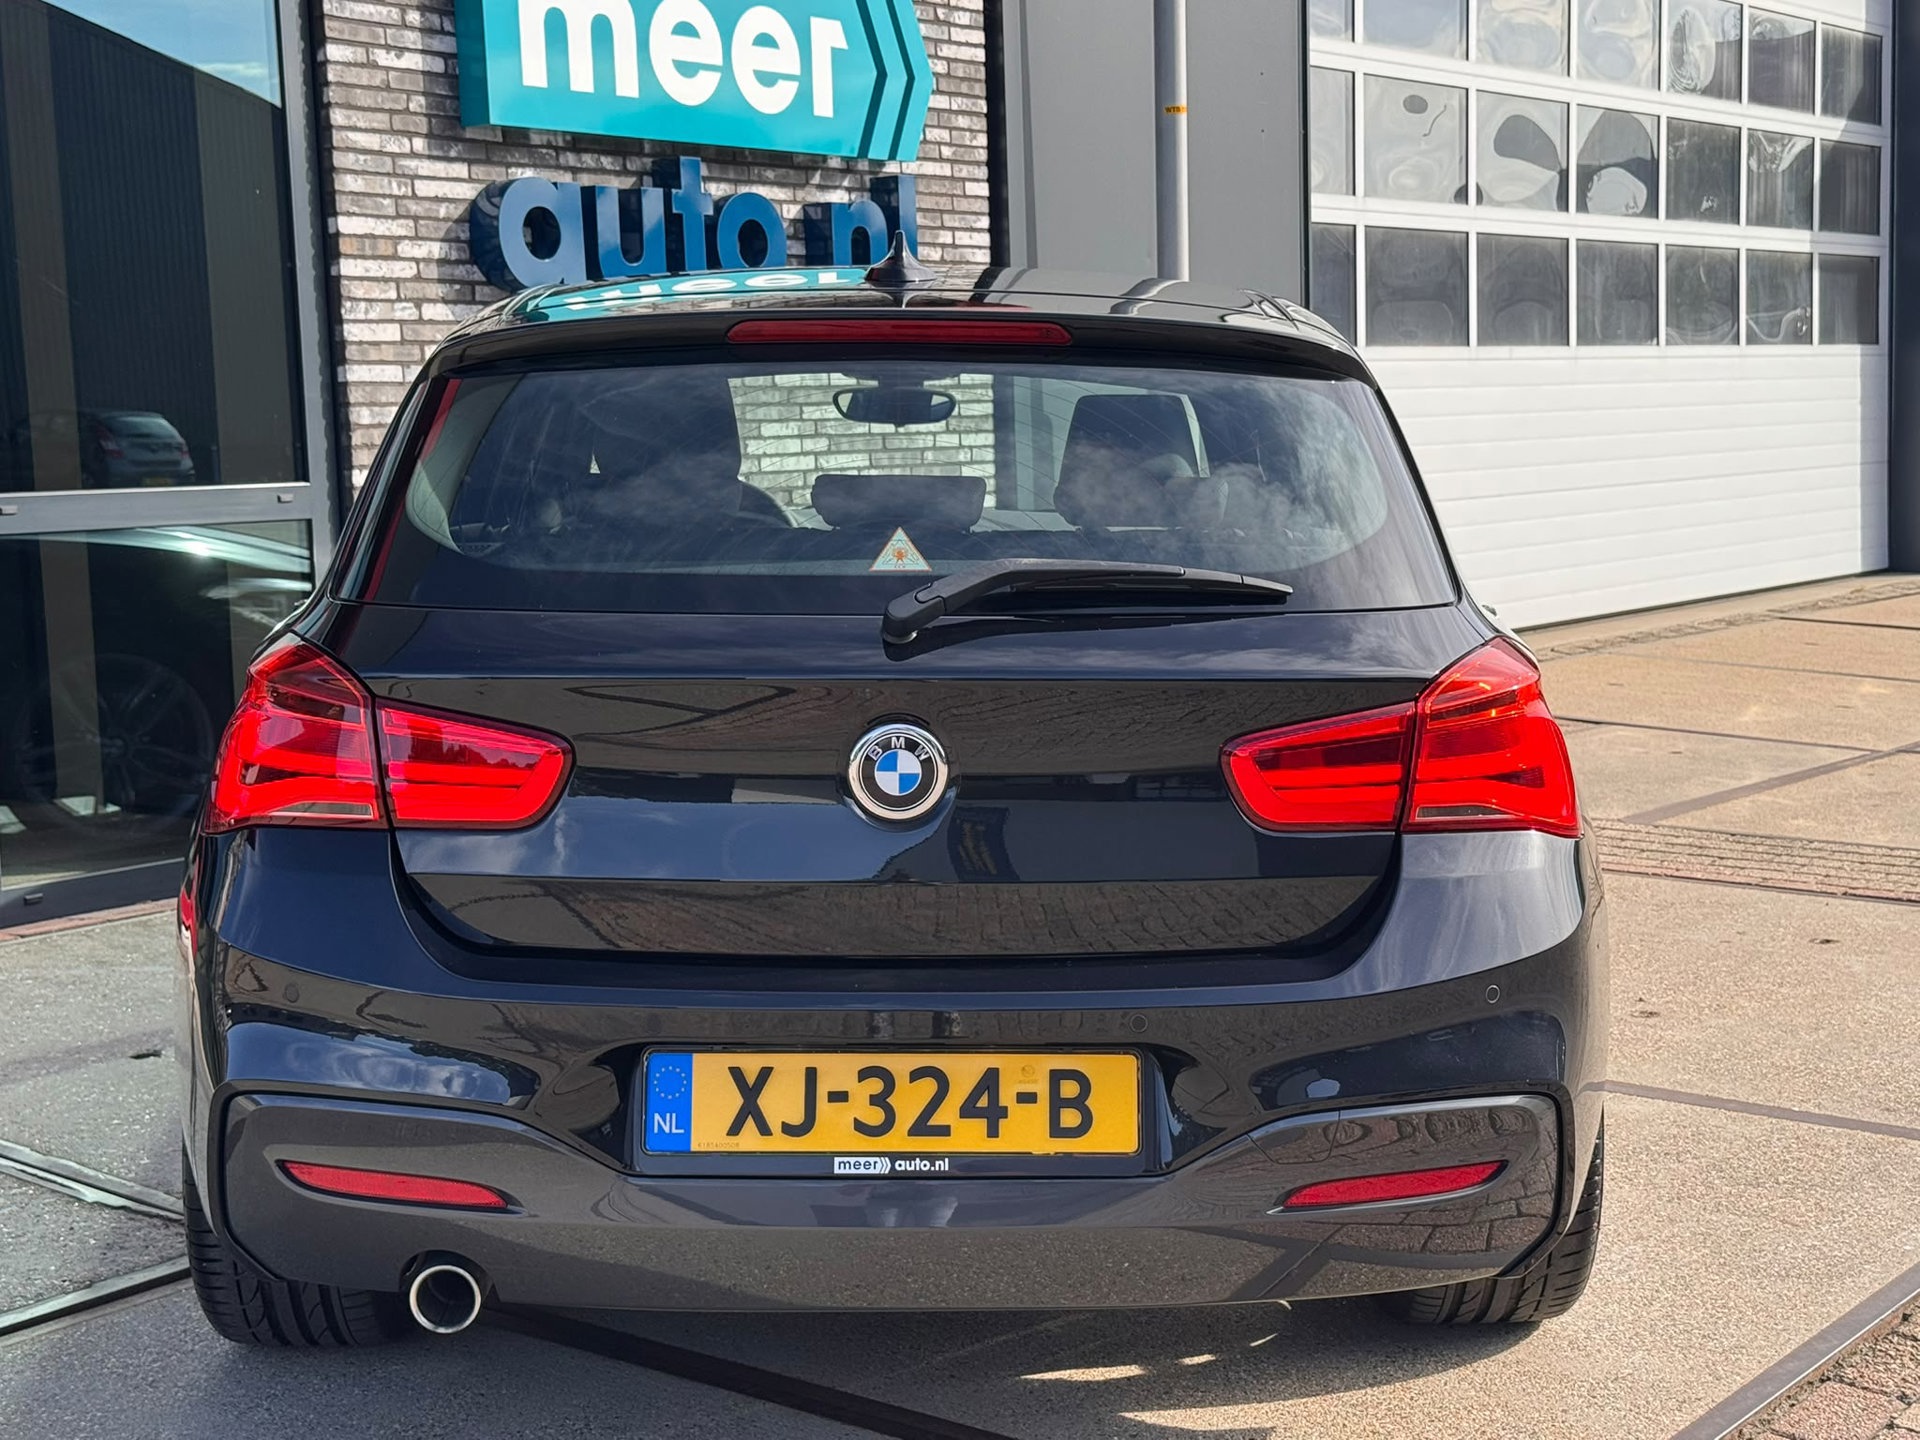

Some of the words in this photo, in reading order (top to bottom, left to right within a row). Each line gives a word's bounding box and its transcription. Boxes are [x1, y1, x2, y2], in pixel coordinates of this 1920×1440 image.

[518, 0, 848, 118] meer
[867, 736, 931, 761] BMW
[726, 1065, 1094, 1139] XJ-324-B
[653, 1112, 685, 1134] NL
[838, 1160, 878, 1170] meer
[895, 1158, 949, 1171] auto.nl
